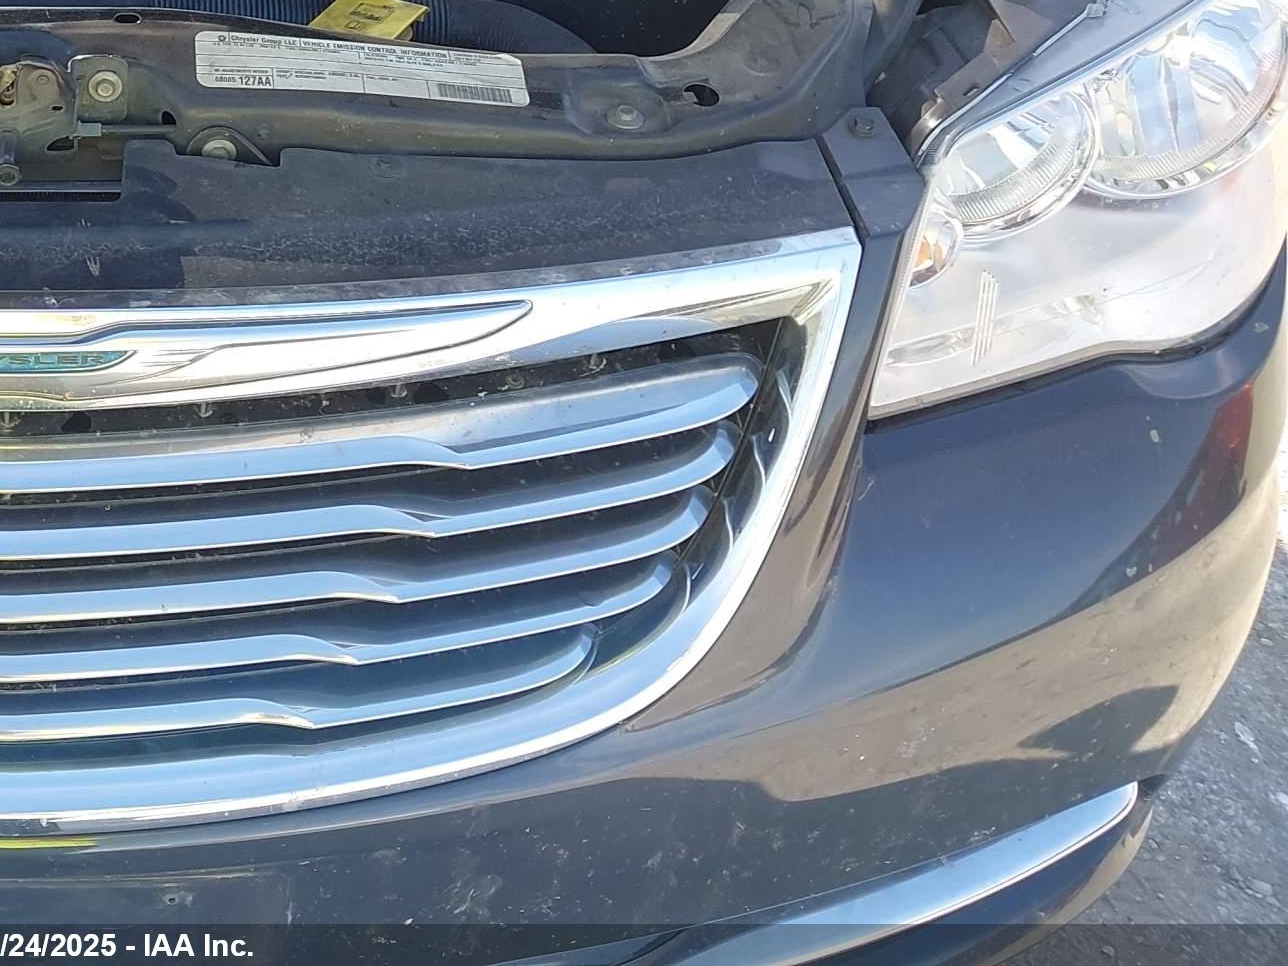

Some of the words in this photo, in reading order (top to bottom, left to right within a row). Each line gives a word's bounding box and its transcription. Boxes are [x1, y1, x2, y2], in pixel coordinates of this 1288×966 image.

[230, 35, 259, 43] Chrysler
[261, 37, 282, 45] Group
[302, 40, 330, 48] VEHICLE
[333, 44, 365, 52] EMISSION
[367, 46, 397, 54] CONTROL
[400, 49, 447, 59] INFORMATION
[238, 76, 272, 87] 127AA
